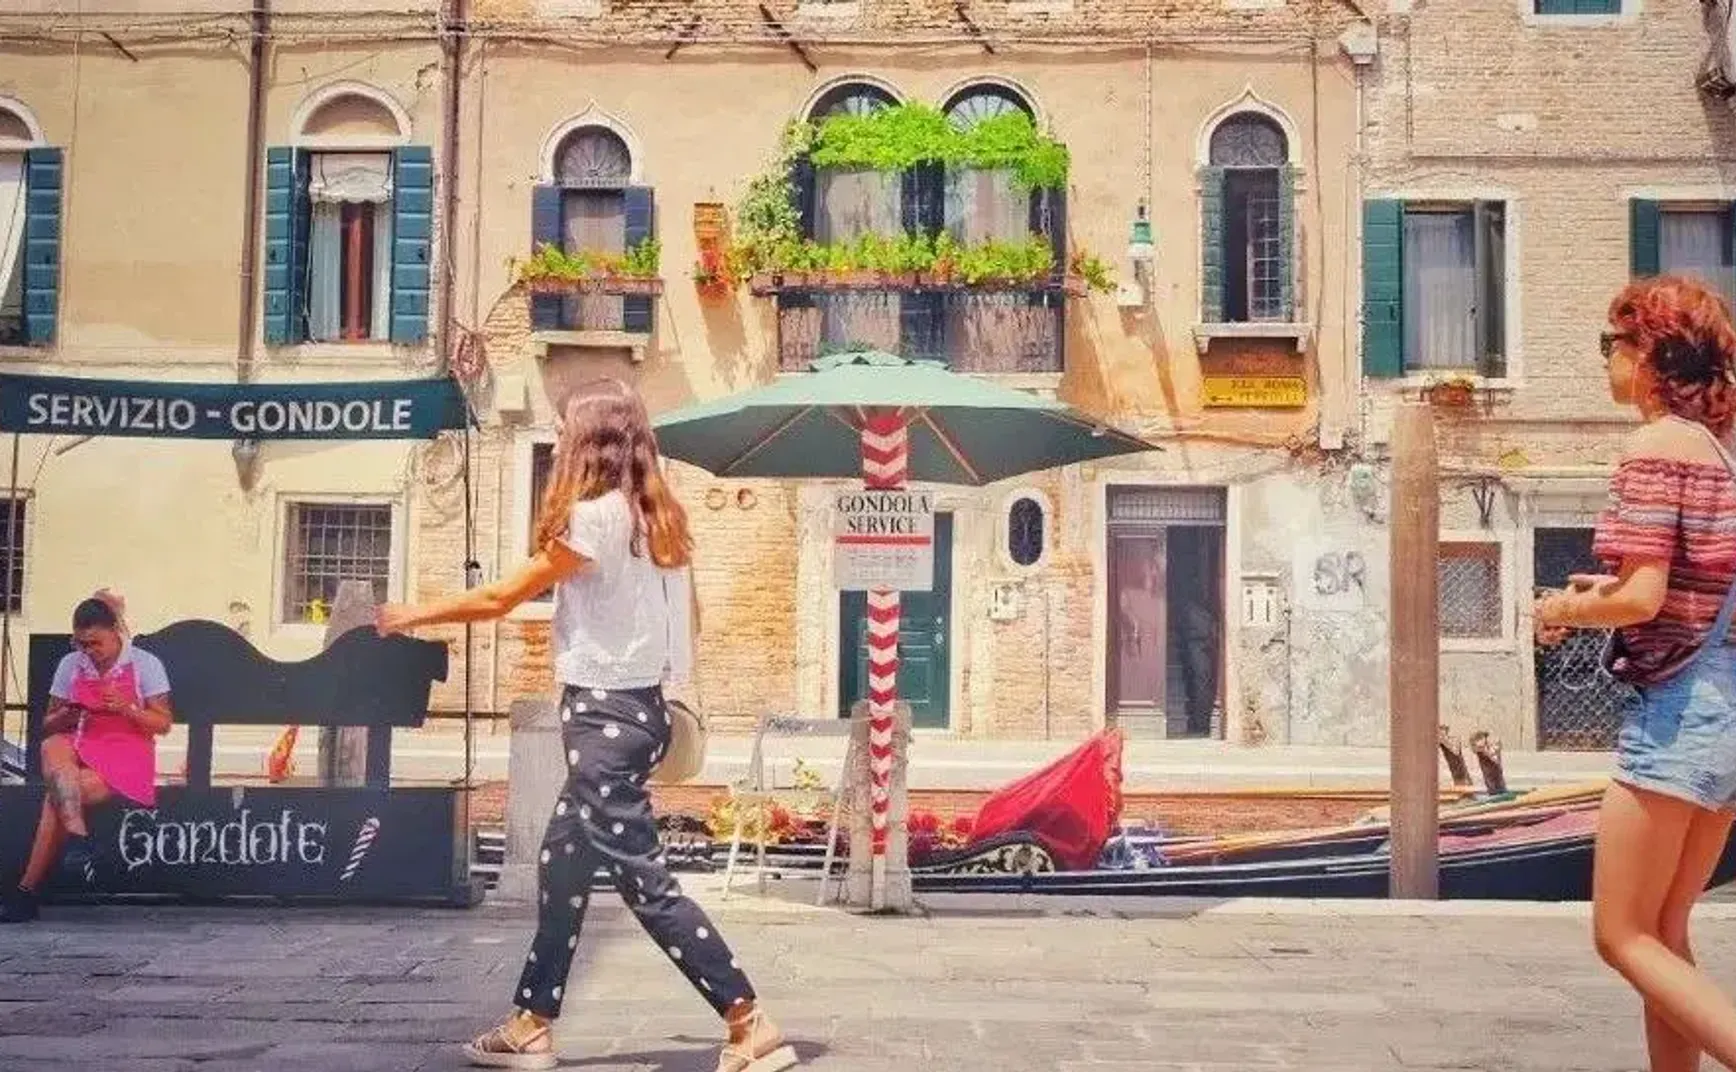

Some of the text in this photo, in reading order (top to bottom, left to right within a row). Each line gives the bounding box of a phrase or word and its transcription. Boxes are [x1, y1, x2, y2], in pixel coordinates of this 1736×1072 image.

[27, 392, 197, 430] SERVIZIO
[230, 399, 413, 432] GONDOLE
[837, 494, 930, 514] GONDOLA
[846, 515, 917, 534] SERVICE
